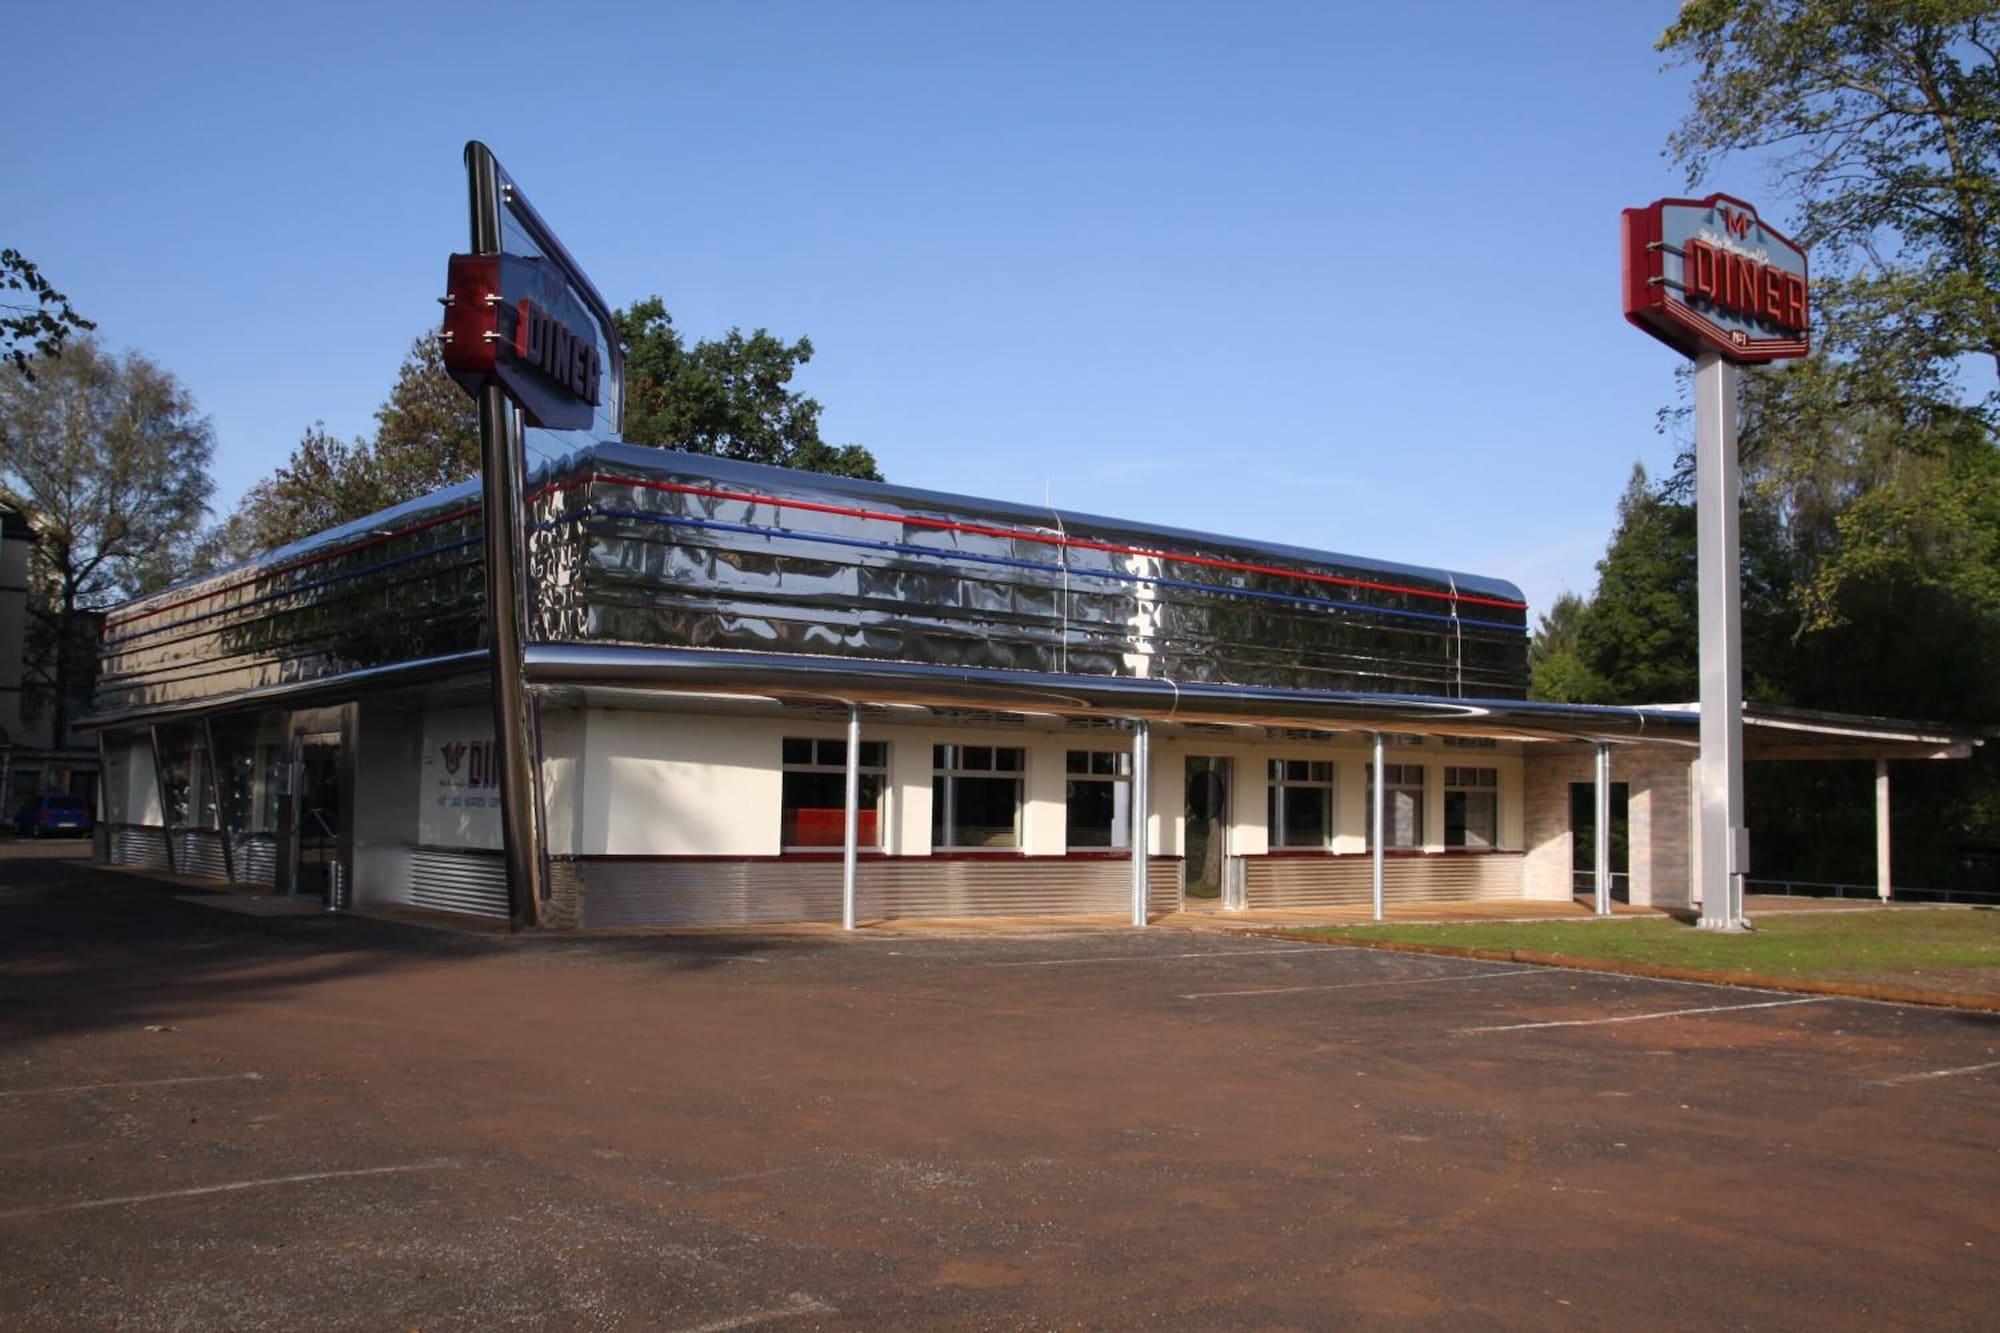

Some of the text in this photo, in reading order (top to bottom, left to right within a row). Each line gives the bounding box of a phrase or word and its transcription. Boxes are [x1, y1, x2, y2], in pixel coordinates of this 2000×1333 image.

[1725, 207, 1749, 240] M
[1689, 240, 1807, 331] DINER
[521, 302, 601, 406] DINER
